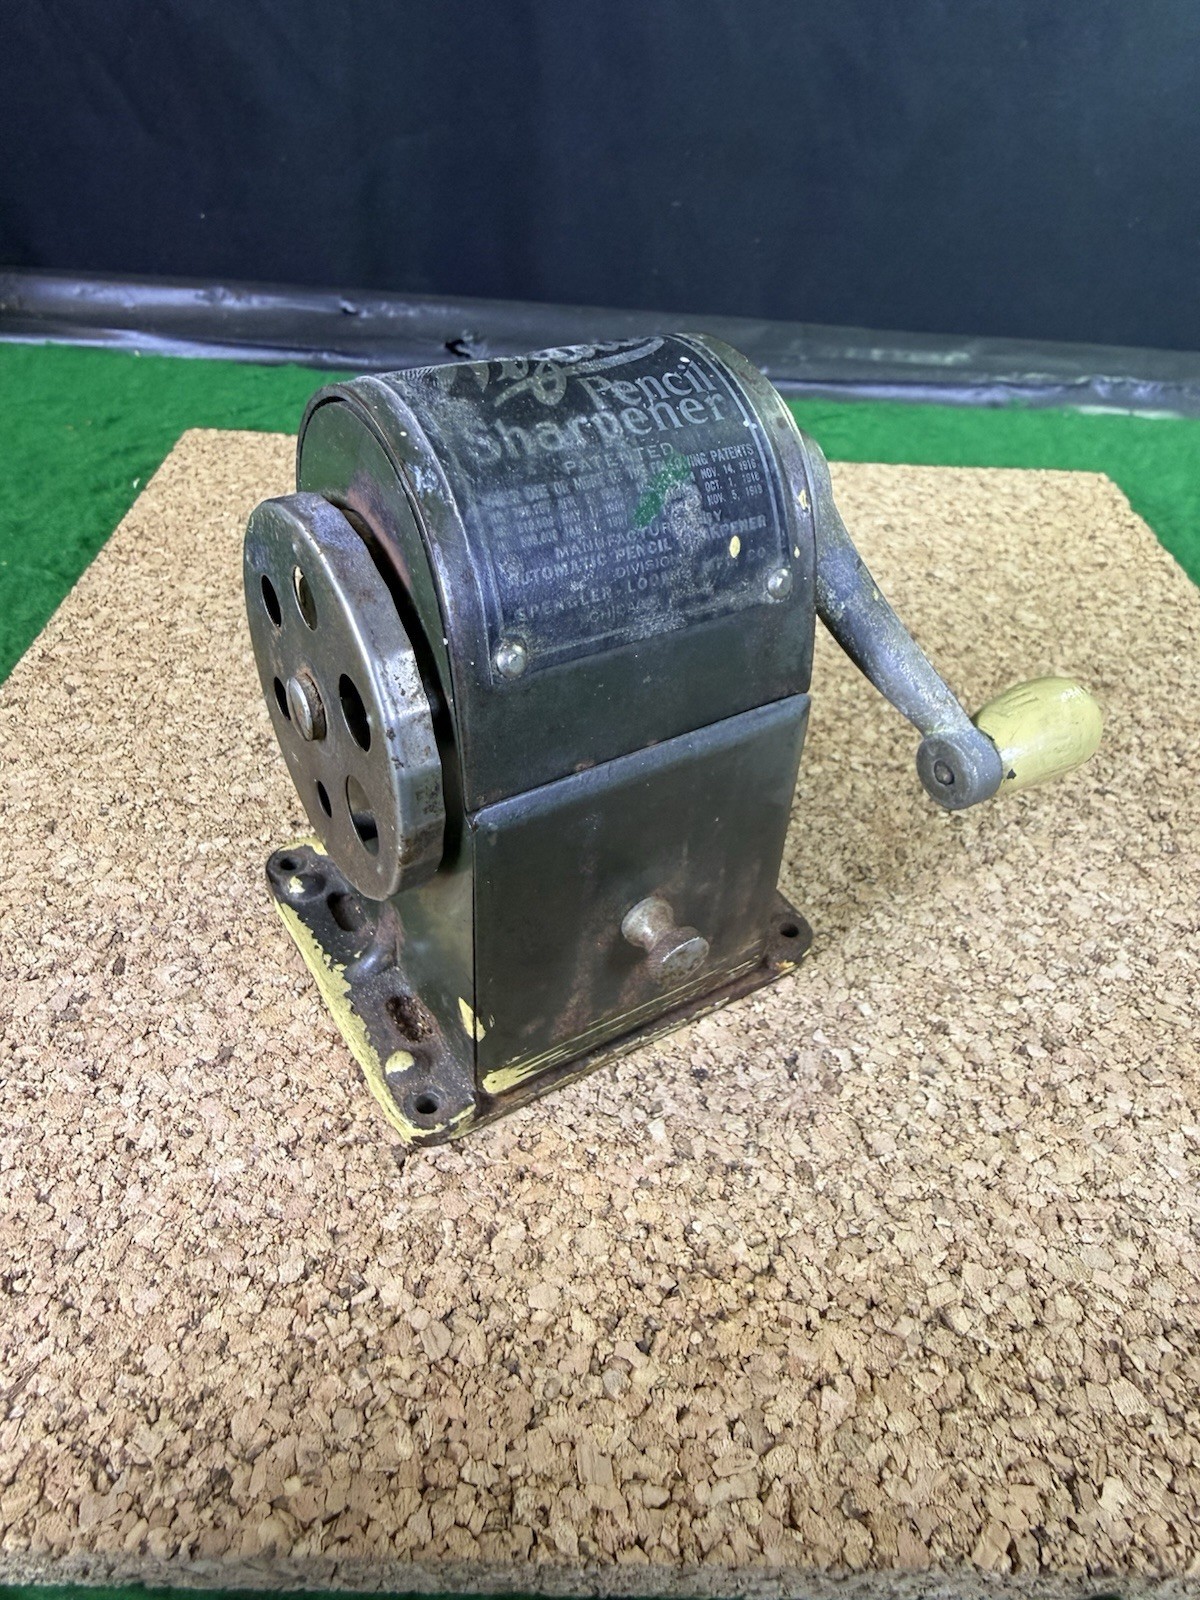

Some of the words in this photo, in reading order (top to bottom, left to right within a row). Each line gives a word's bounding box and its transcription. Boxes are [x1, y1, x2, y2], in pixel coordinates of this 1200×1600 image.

[577, 359, 717, 410] Pencil
[564, 442, 674, 476] PATENTED
[710, 443, 755, 462] PATENTS
[700, 467, 720, 479] NOV.
[704, 480, 723, 493] OCT.
[555, 521, 688, 559] MANUFACTUR
[615, 537, 673, 562] PENCIL
